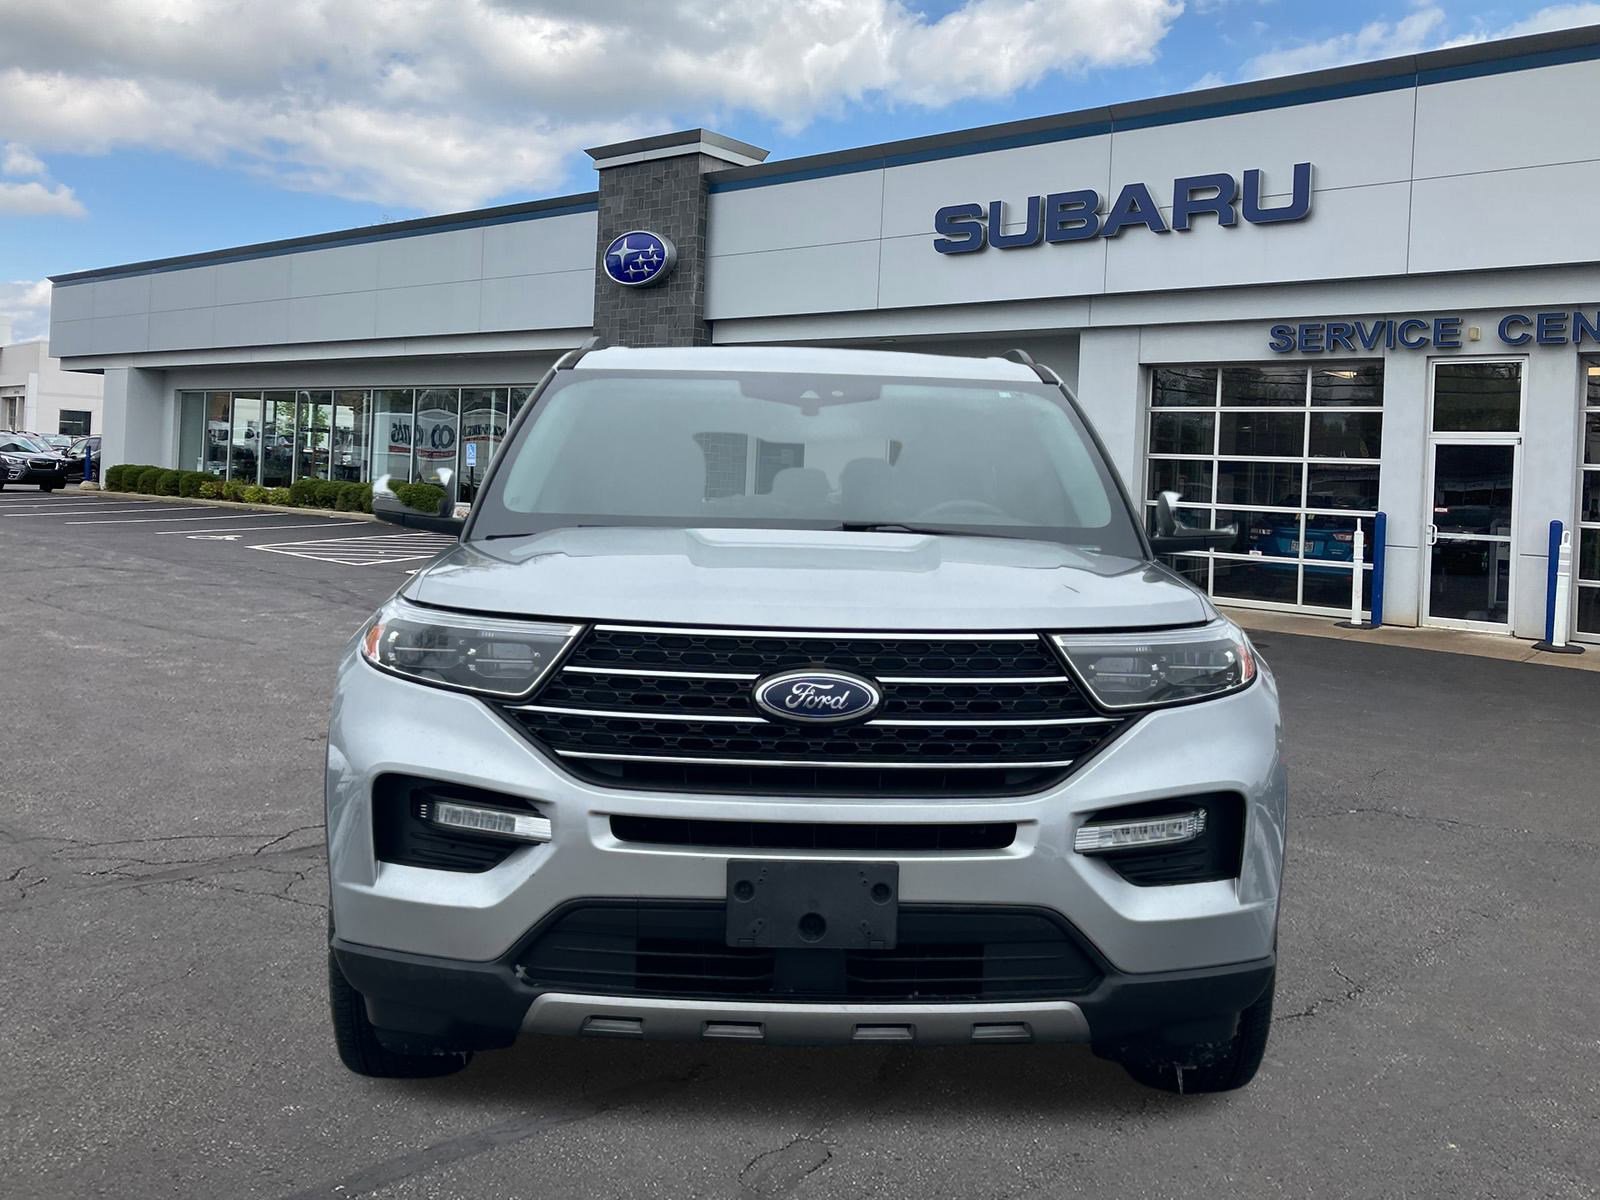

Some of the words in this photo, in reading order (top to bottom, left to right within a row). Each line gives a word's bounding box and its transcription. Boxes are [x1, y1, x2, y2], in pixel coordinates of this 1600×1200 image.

[933, 161, 1313, 255] SUBARU
[1268, 317, 1463, 353] SERVICE
[1497, 311, 1600, 345] CEN
[785, 682, 851, 710] Ford
